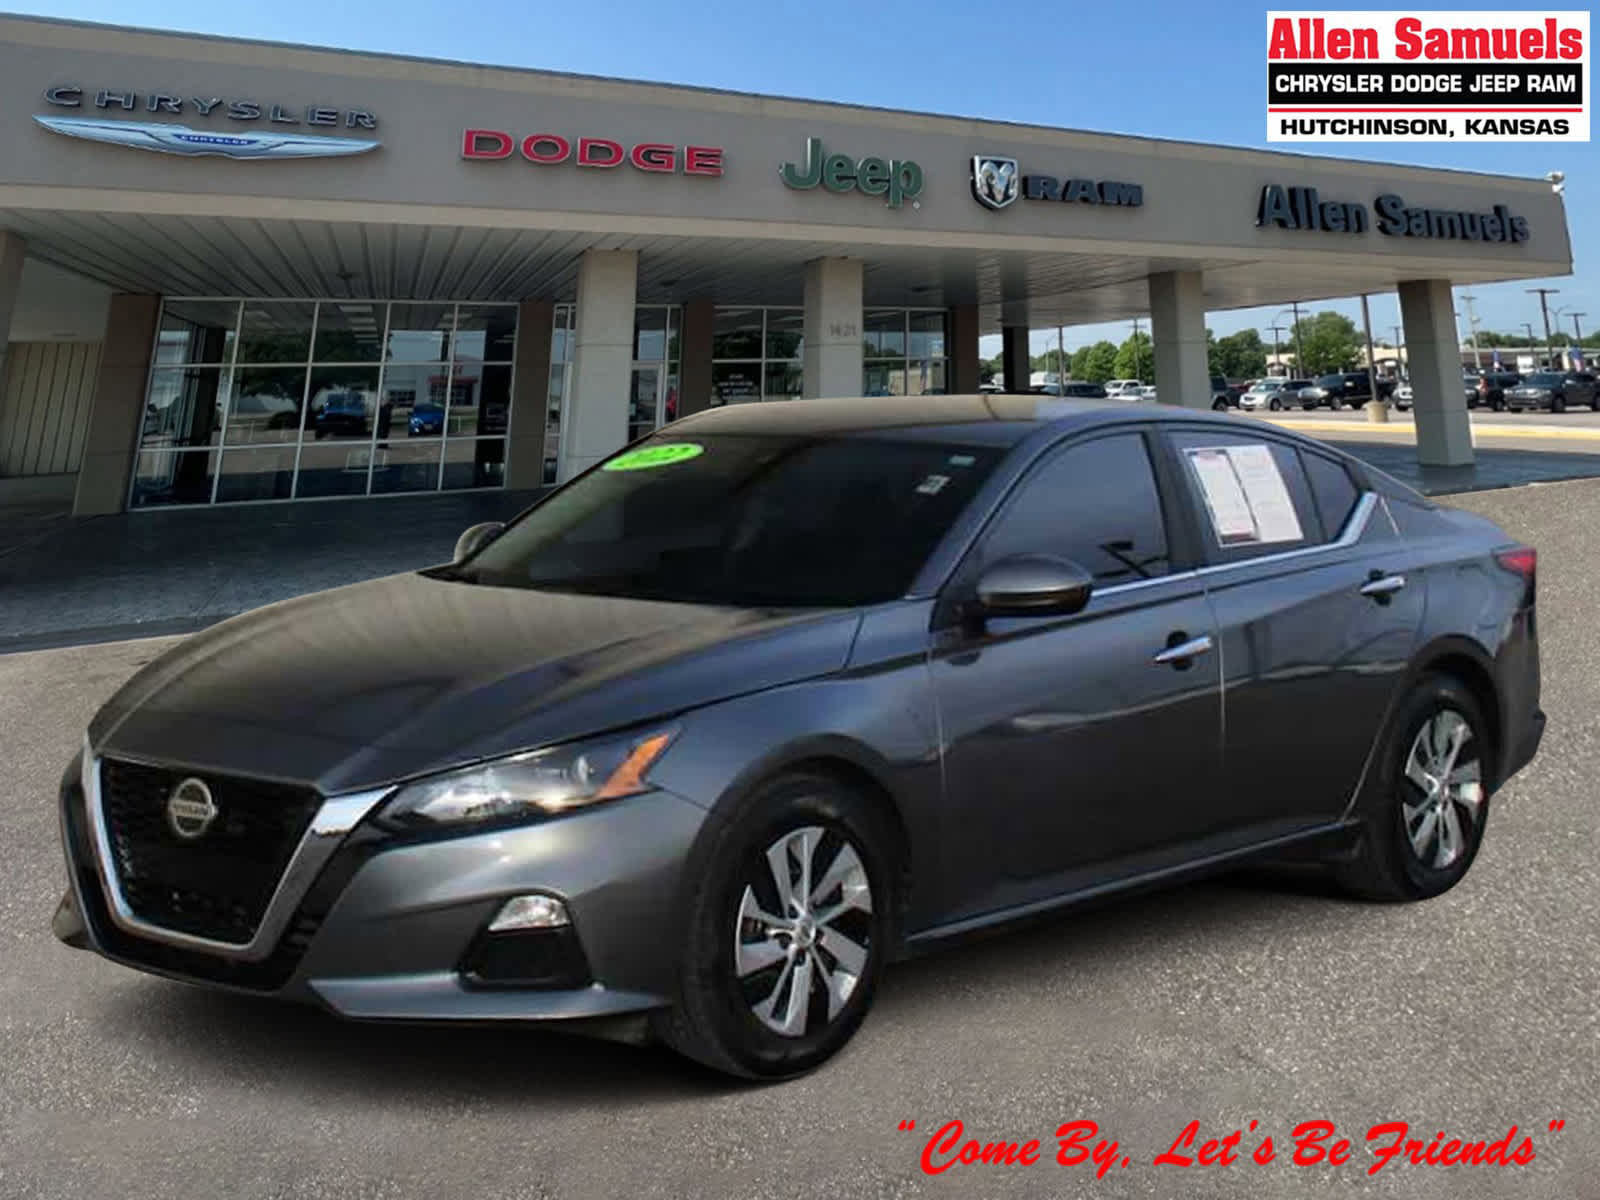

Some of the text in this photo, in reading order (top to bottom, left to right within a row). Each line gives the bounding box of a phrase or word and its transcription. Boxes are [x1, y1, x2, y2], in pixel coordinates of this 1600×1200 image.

[45, 86, 377, 128] CHRYSLER
[461, 128, 724, 176] DODGE
[778, 136, 923, 209] Jeep
[1022, 176, 1143, 207] RAM
[1256, 184, 1530, 243] Allen Samuels
